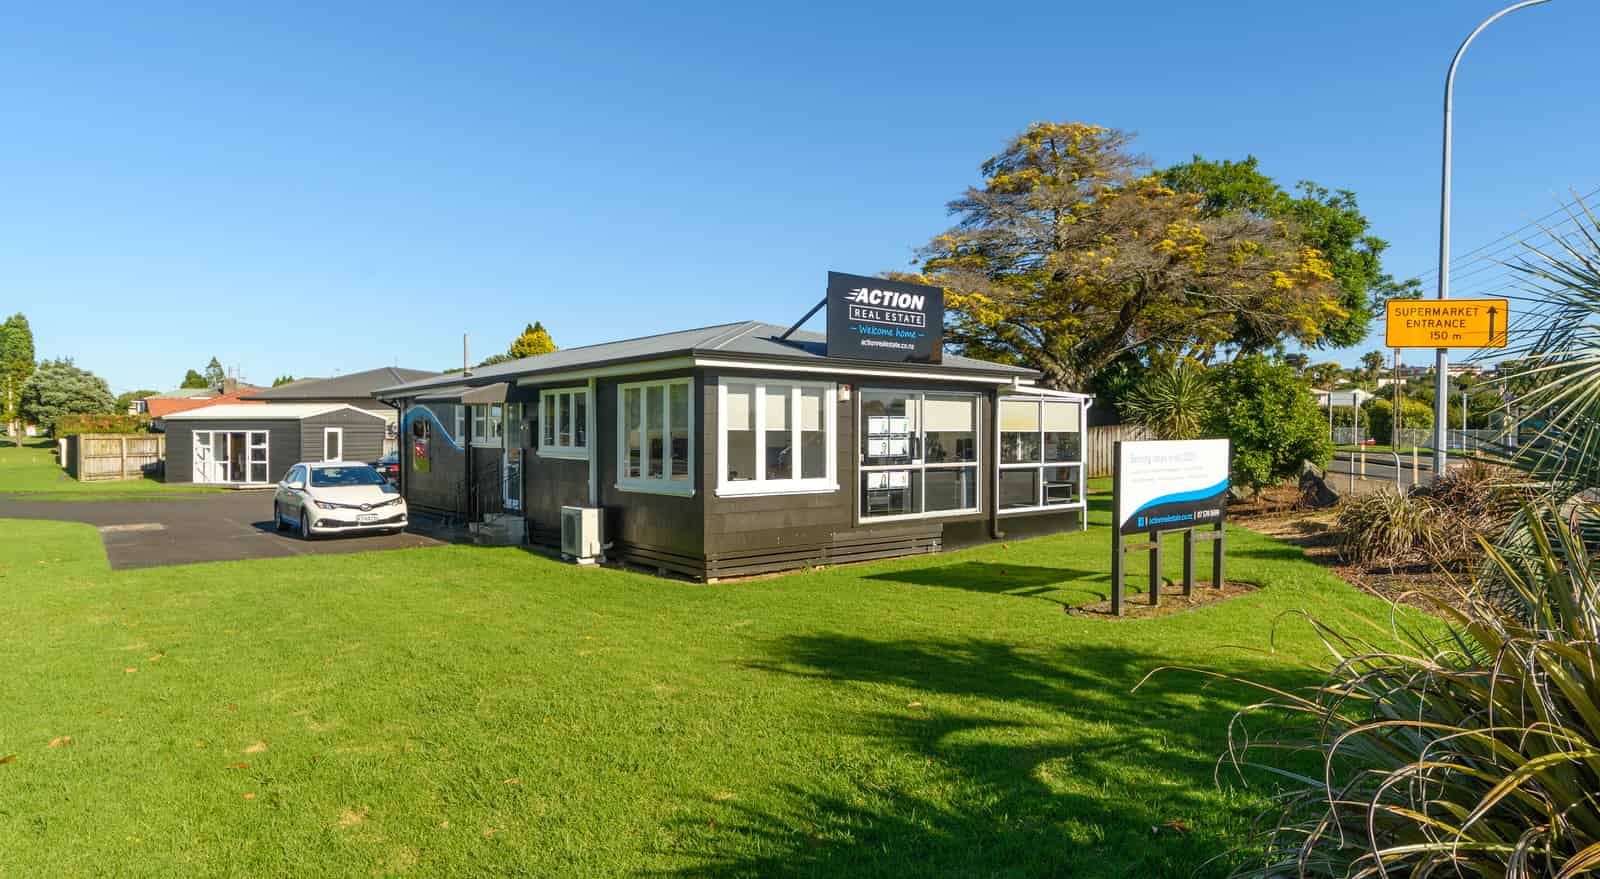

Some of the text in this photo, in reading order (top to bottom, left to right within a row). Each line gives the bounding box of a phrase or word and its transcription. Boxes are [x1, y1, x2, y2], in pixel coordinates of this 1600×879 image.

[855, 288, 925, 310] ACTION
[854, 309, 922, 325] REAL ESTATE
[1394, 307, 1479, 317] SUPERMARKET
[1406, 319, 1467, 329] ENTRANCE
[859, 325, 917, 338] Welcome home
[1429, 331, 1449, 340] 150
